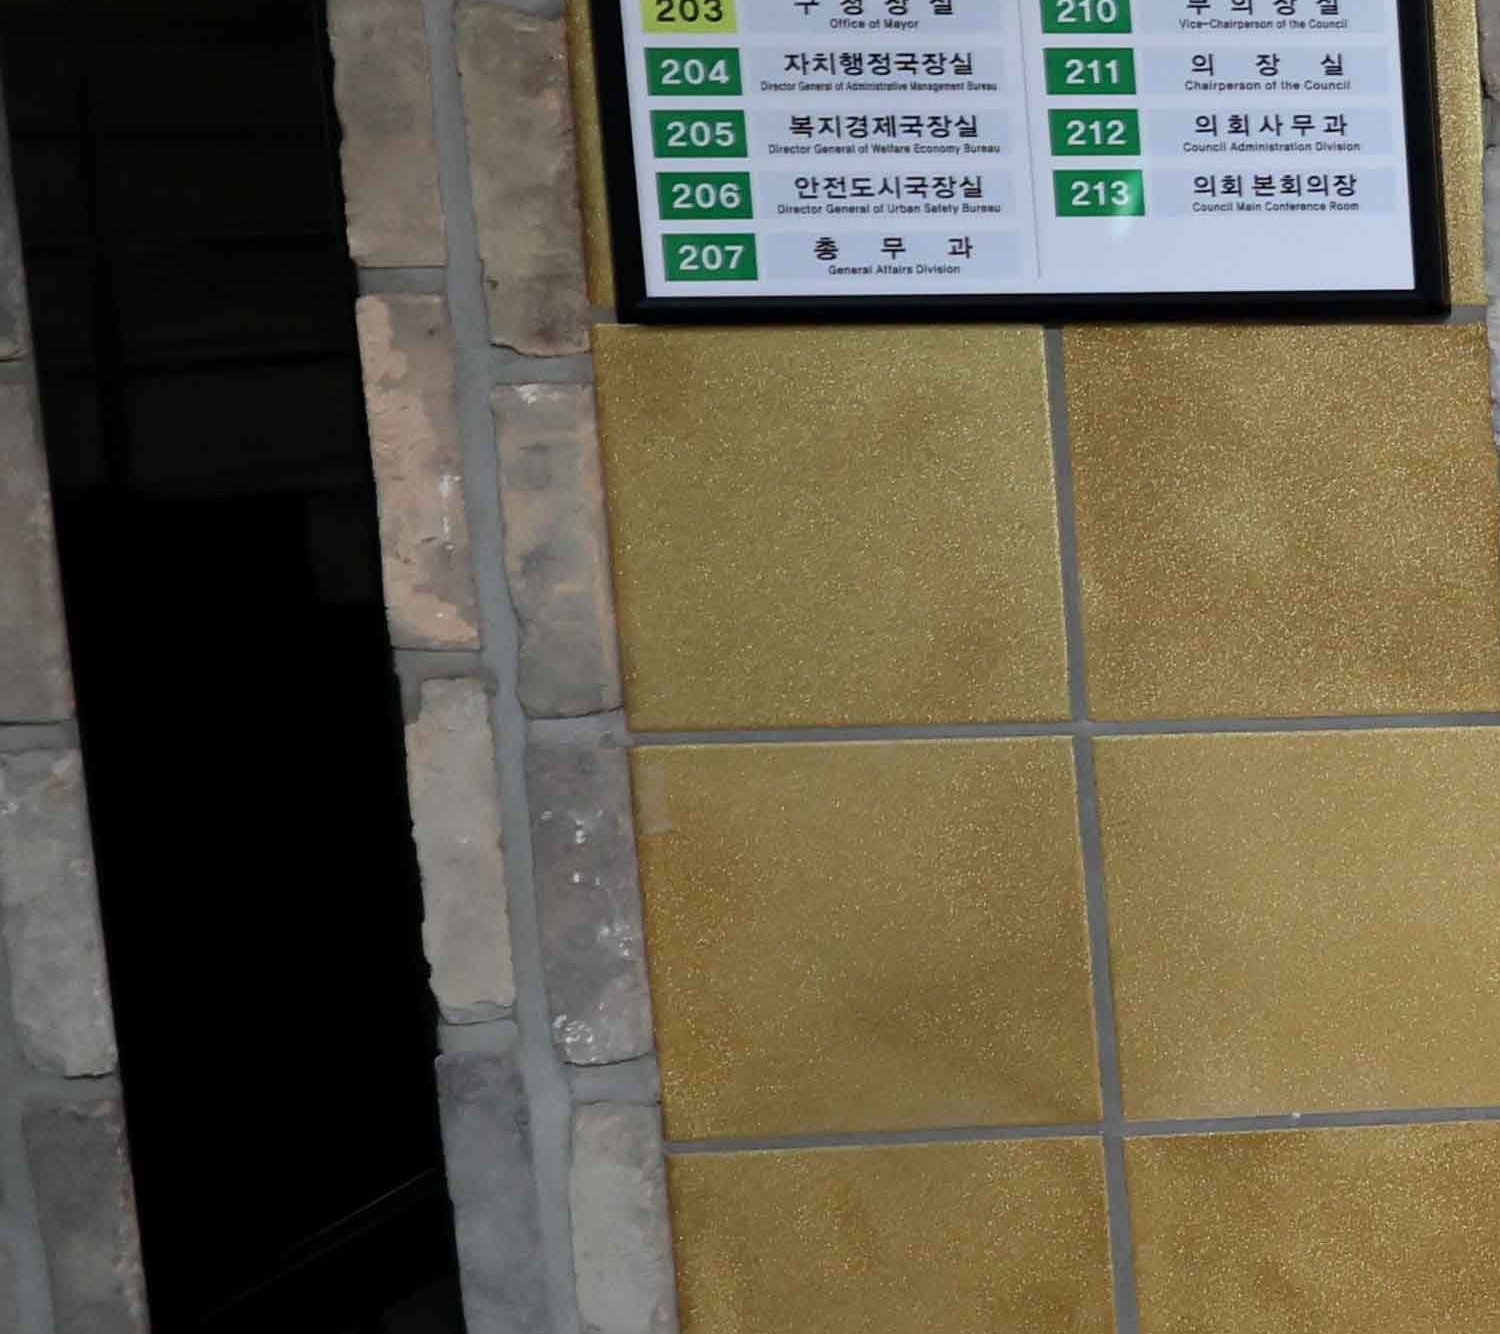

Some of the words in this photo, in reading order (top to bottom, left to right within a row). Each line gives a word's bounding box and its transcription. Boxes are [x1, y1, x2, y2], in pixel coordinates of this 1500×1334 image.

[829, 17, 866, 29] Office
[868, 18, 881, 29] of
[883, 18, 919, 31] Mayor
[1275, 18, 1287, 30] of
[1288, 19, 1307, 30] the
[1308, 18, 1348, 30] Council
[660, 58, 730, 85] 204
[784, 52, 973, 77] 자치행정국장실
[1065, 58, 1119, 84] 211
[760, 80, 796, 92] Director
[797, 80, 833, 92] General
[834, 81, 844, 92] of
[845, 81, 908, 92] Administrative
[909, 81, 965, 93] Management
[966, 80, 998, 92] Bureau
[1184, 79, 1262, 92] Chairperson
[1264, 80, 1278, 91] of
[1280, 80, 1301, 91] the
[1303, 79, 1351, 91] Council
[666, 120, 736, 147] 205
[788, 114, 978, 139] 복지경제국장실
[1066, 119, 1127, 146] 212
[767, 143, 811, 155] Director
[813, 143, 856, 155] General
[857, 143, 869, 154] of
[870, 143, 911, 154] Welfare
[913, 142, 961, 155] Economy
[963, 142, 1001, 154] Bureau
[1183, 141, 1227, 153] Council
[1230, 141, 1312, 153] Administration
[1315, 141, 1361, 152] Division
[671, 182, 742, 209] 206
[794, 175, 983, 200] 안전도시국장실
[1071, 180, 1132, 208] 213
[1193, 174, 1243, 198] 의회
[1253, 174, 1357, 197] 본회의장
[777, 203, 823, 215] Director
[825, 203, 870, 215] General
[872, 203, 884, 214] of
[887, 204, 921, 214] Urban
[923, 202, 959, 215] Safety
[961, 202, 1001, 213] Bureau
[1192, 201, 1234, 212] Council
[1236, 202, 1262, 212] Main
[1264, 201, 1327, 212] Conference
[1329, 200, 1360, 211] Room
[677, 244, 745, 271] 207
[828, 264, 873, 276] General
[875, 264, 914, 275] Affairs
[915, 263, 961, 275] Division
